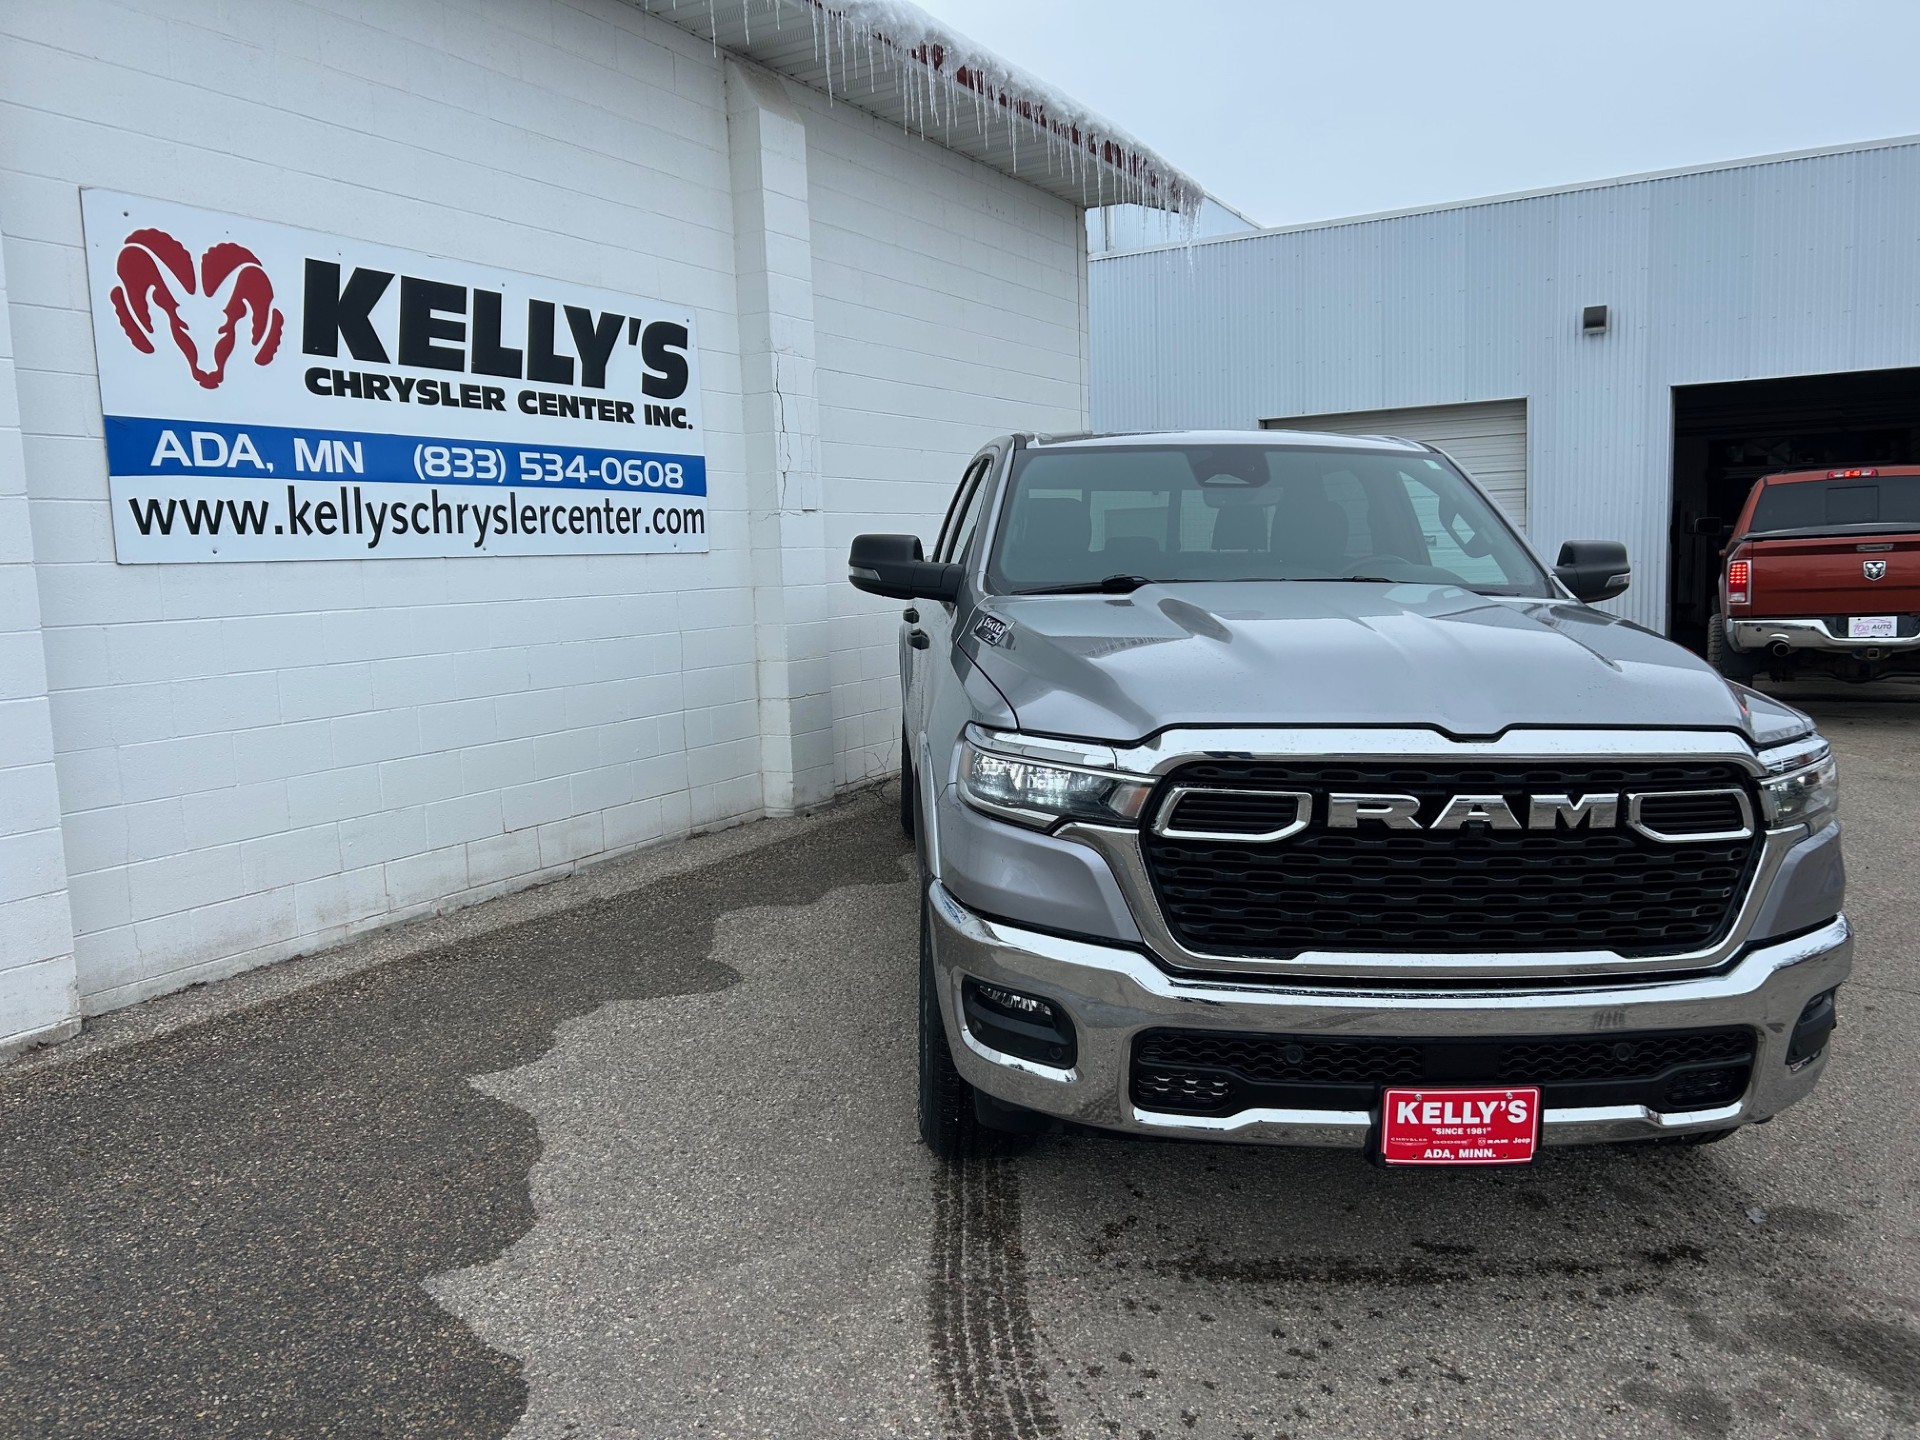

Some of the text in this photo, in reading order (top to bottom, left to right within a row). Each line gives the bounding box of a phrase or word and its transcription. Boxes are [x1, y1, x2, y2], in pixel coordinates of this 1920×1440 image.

[302, 258, 690, 400] KELLY'S
[304, 366, 694, 430] CHRYSLER CENTER INC.
[150, 429, 684, 489] ADA, MN (833) 534-0608
[128, 485, 706, 549] www.kellyschryslercenter.com
[1327, 792, 1620, 830] RAM
[1396, 1100, 1528, 1125] KELLY'S
[1431, 1127, 1464, 1135] "SINCE
[1423, 1148, 1497, 1160] ADA, MINN.
